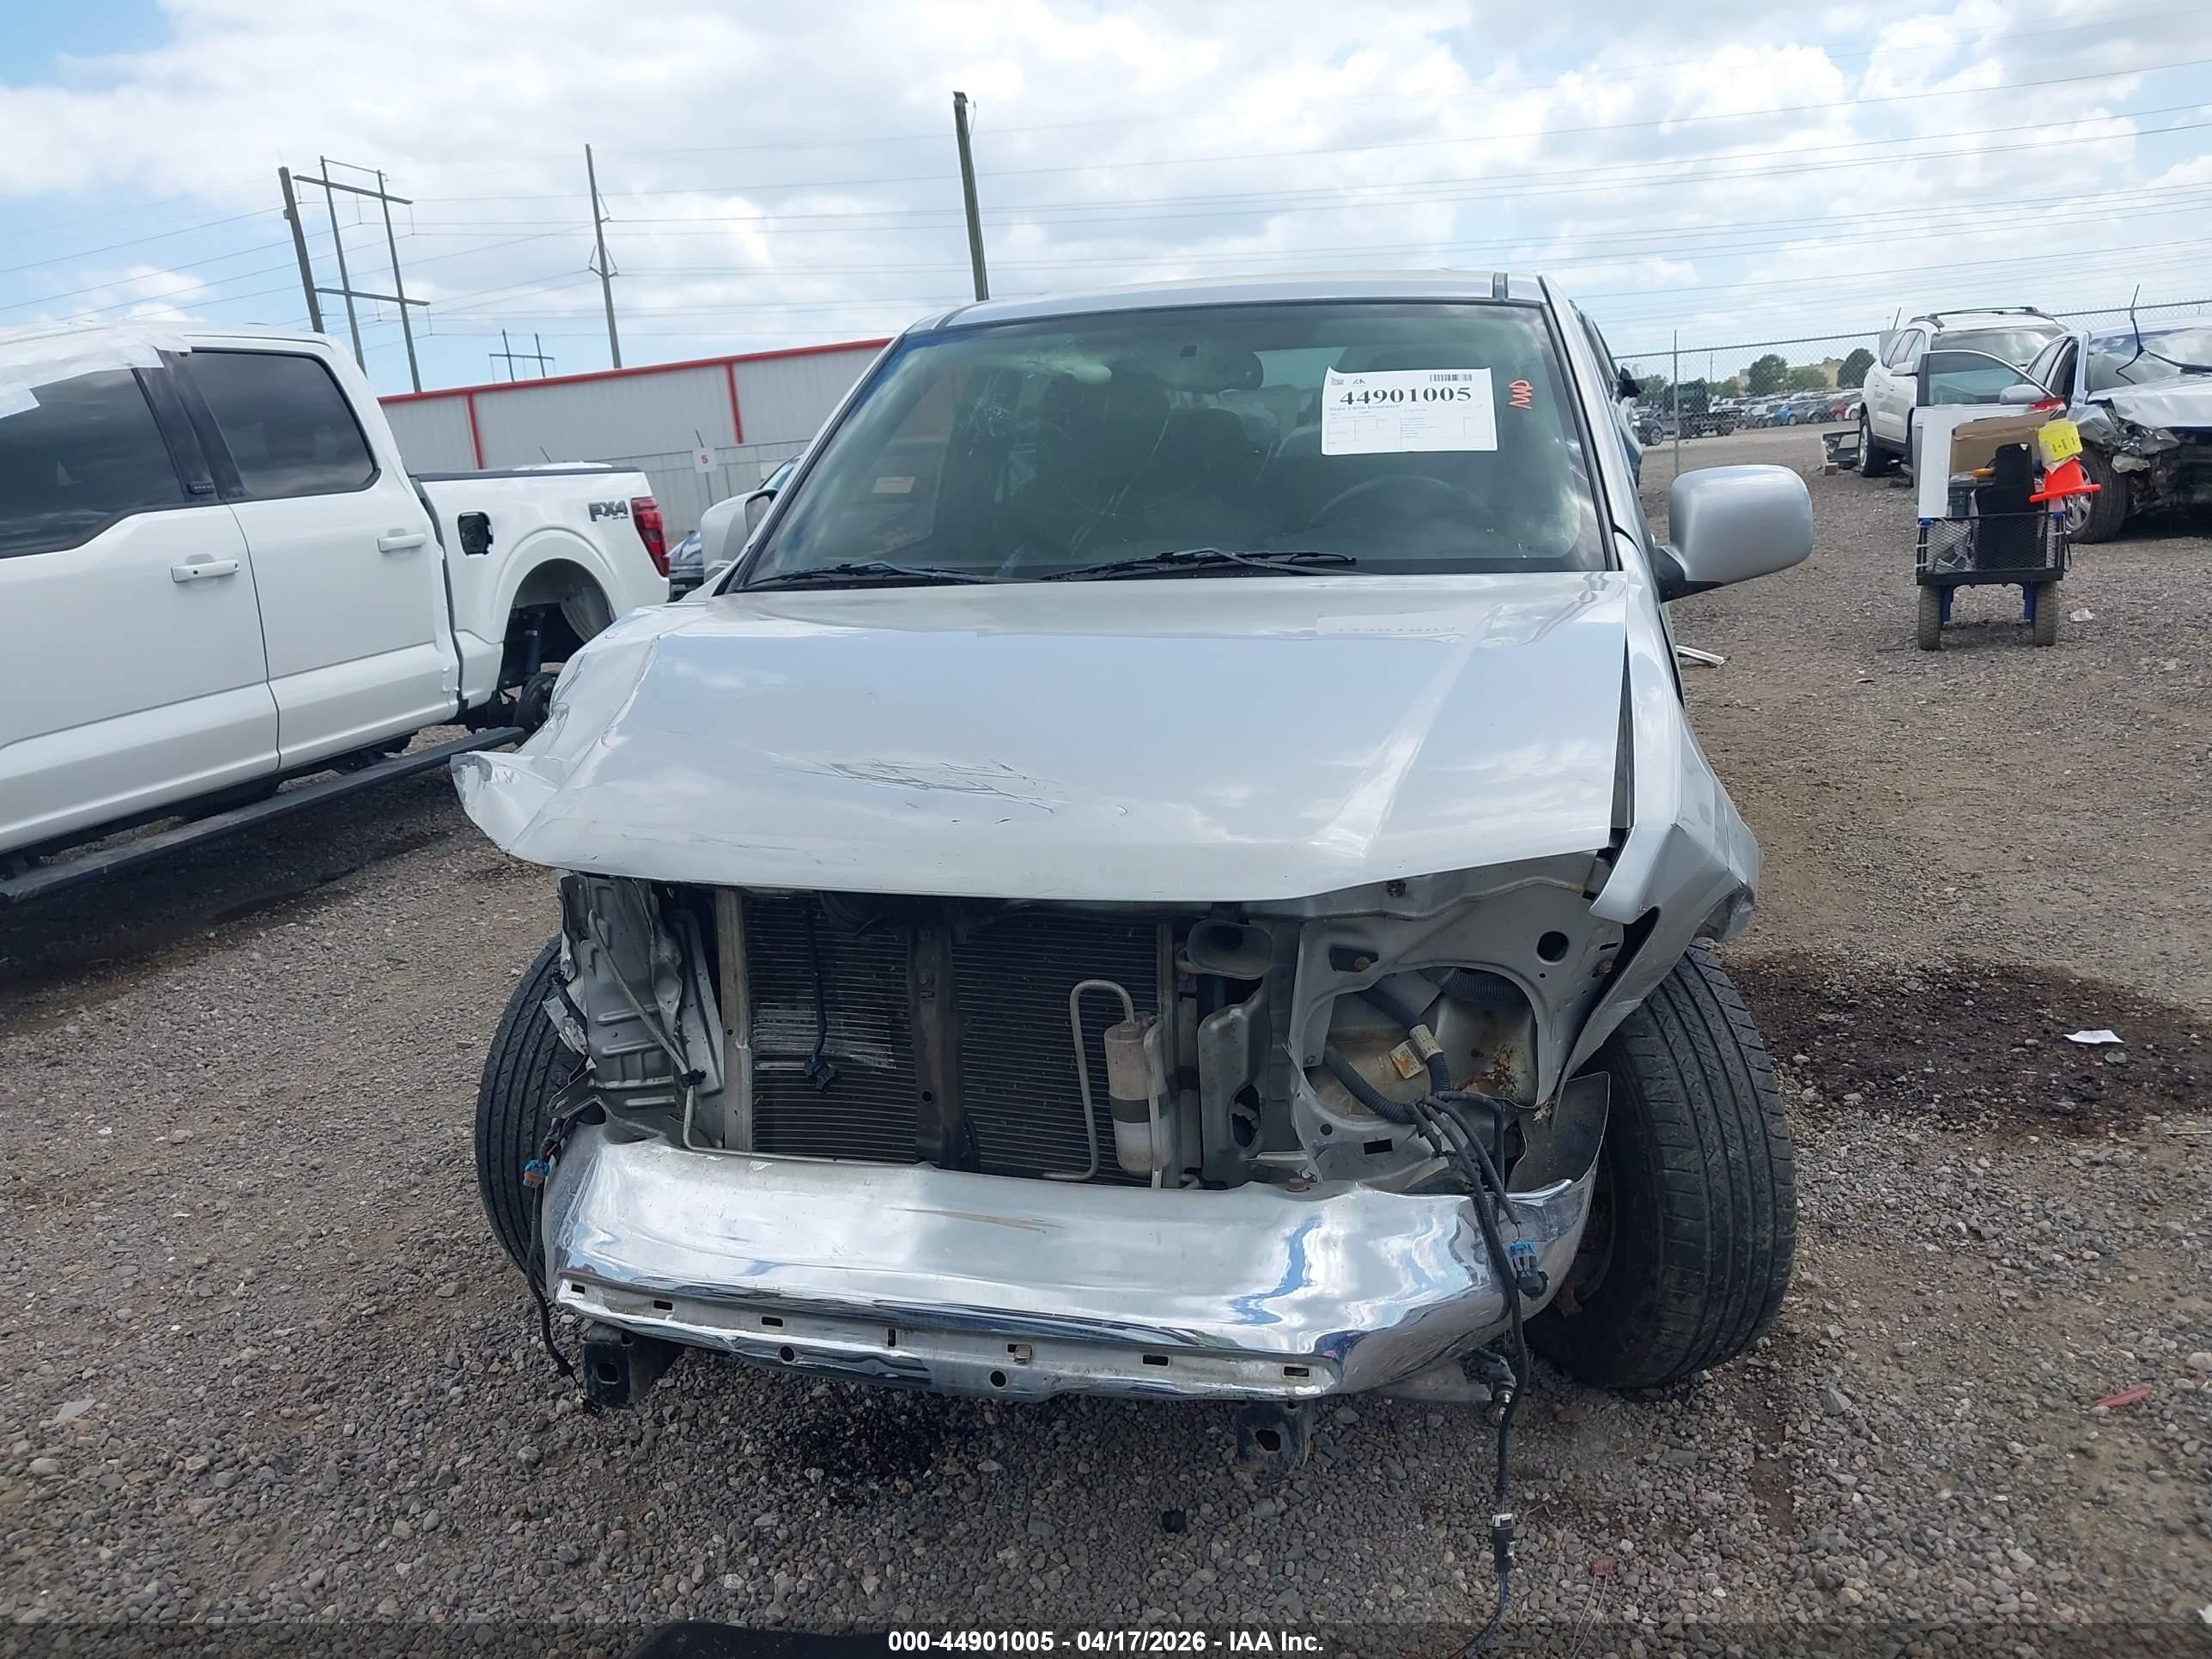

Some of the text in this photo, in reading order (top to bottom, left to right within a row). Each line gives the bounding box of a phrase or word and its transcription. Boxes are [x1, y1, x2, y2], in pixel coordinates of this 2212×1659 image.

[1340, 386, 1472, 404] 44901005
[701, 454, 708, 464] 5
[588, 501, 628, 522] FX4
